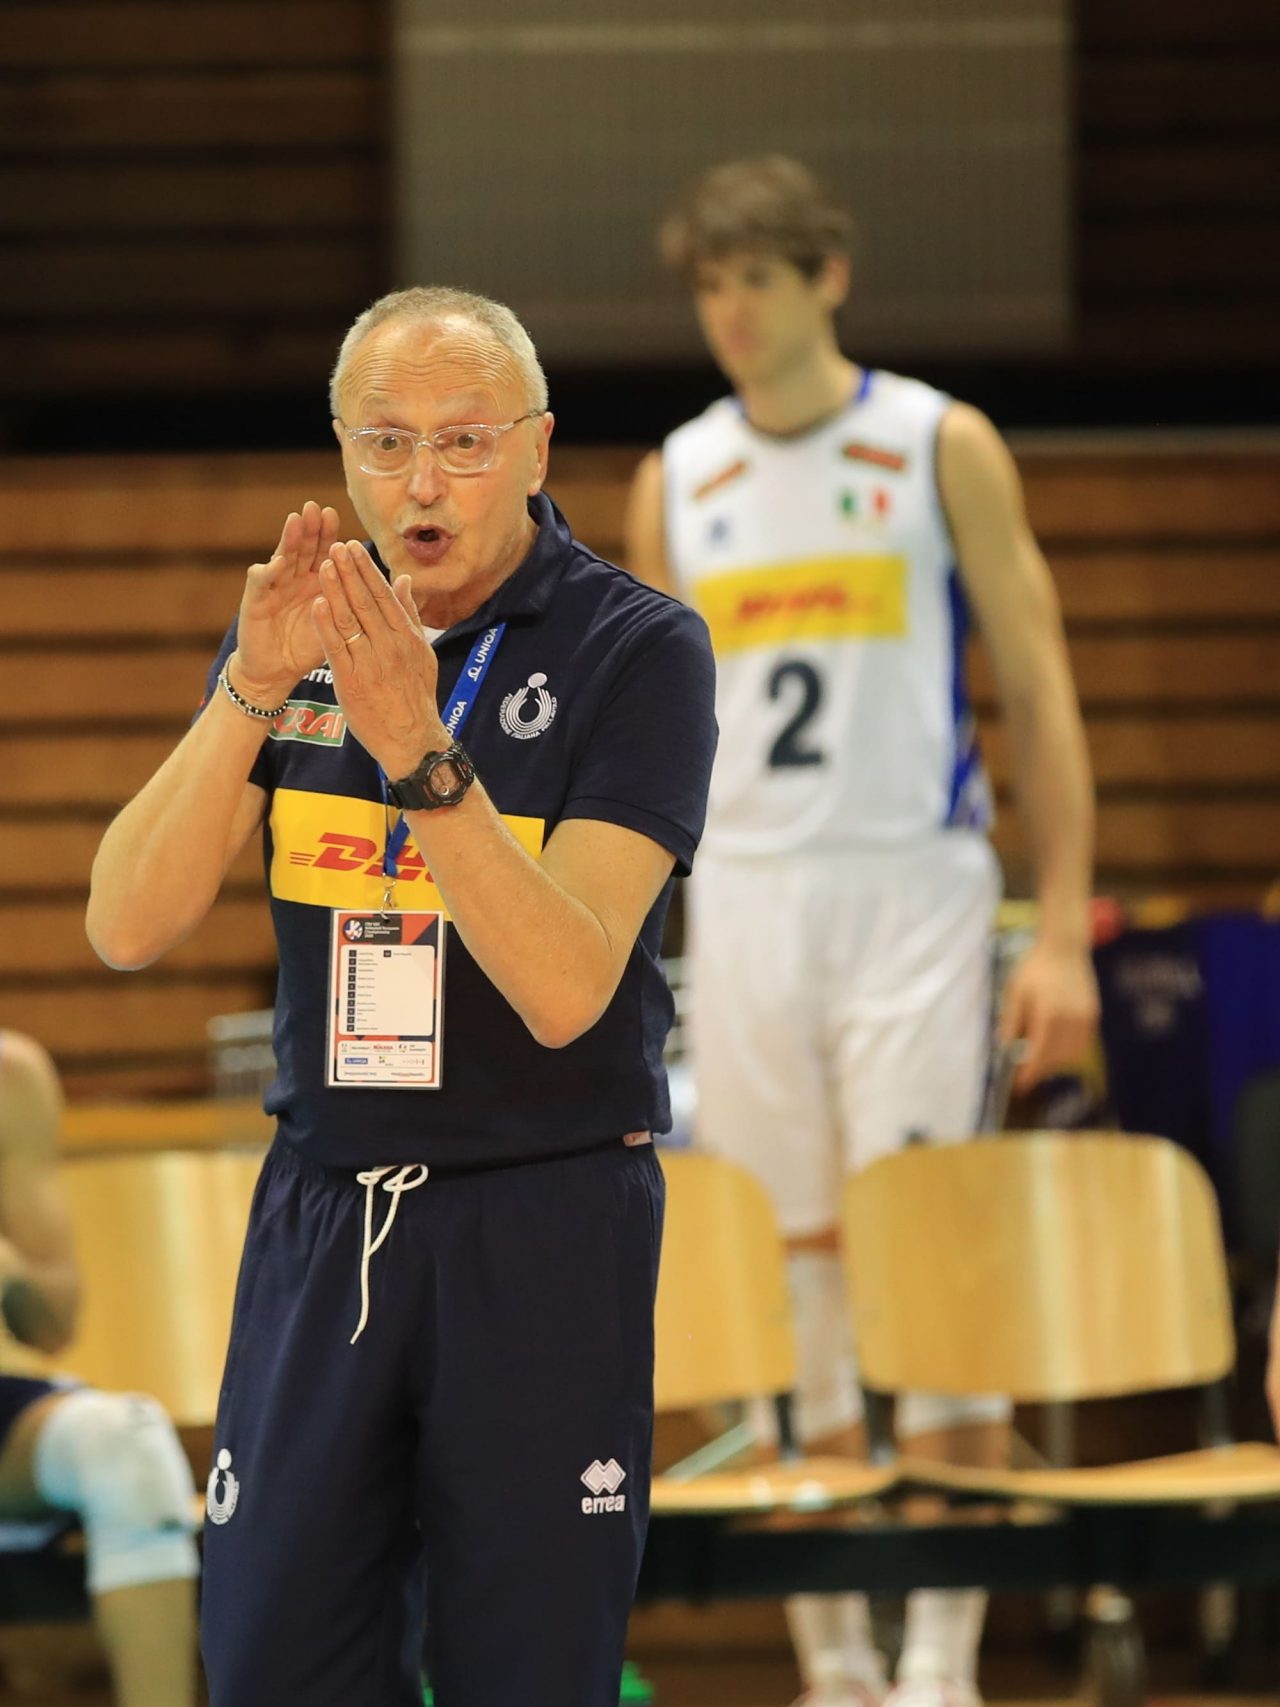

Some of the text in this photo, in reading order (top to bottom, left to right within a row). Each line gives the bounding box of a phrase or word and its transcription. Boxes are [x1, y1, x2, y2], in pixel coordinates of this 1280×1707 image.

[473, 627, 498, 664] UNIQA
[445, 700, 467, 737] UNIQA
[766, 655, 828, 771] 2
[311, 832, 436, 884] DH
[581, 1494, 626, 1515] errea
